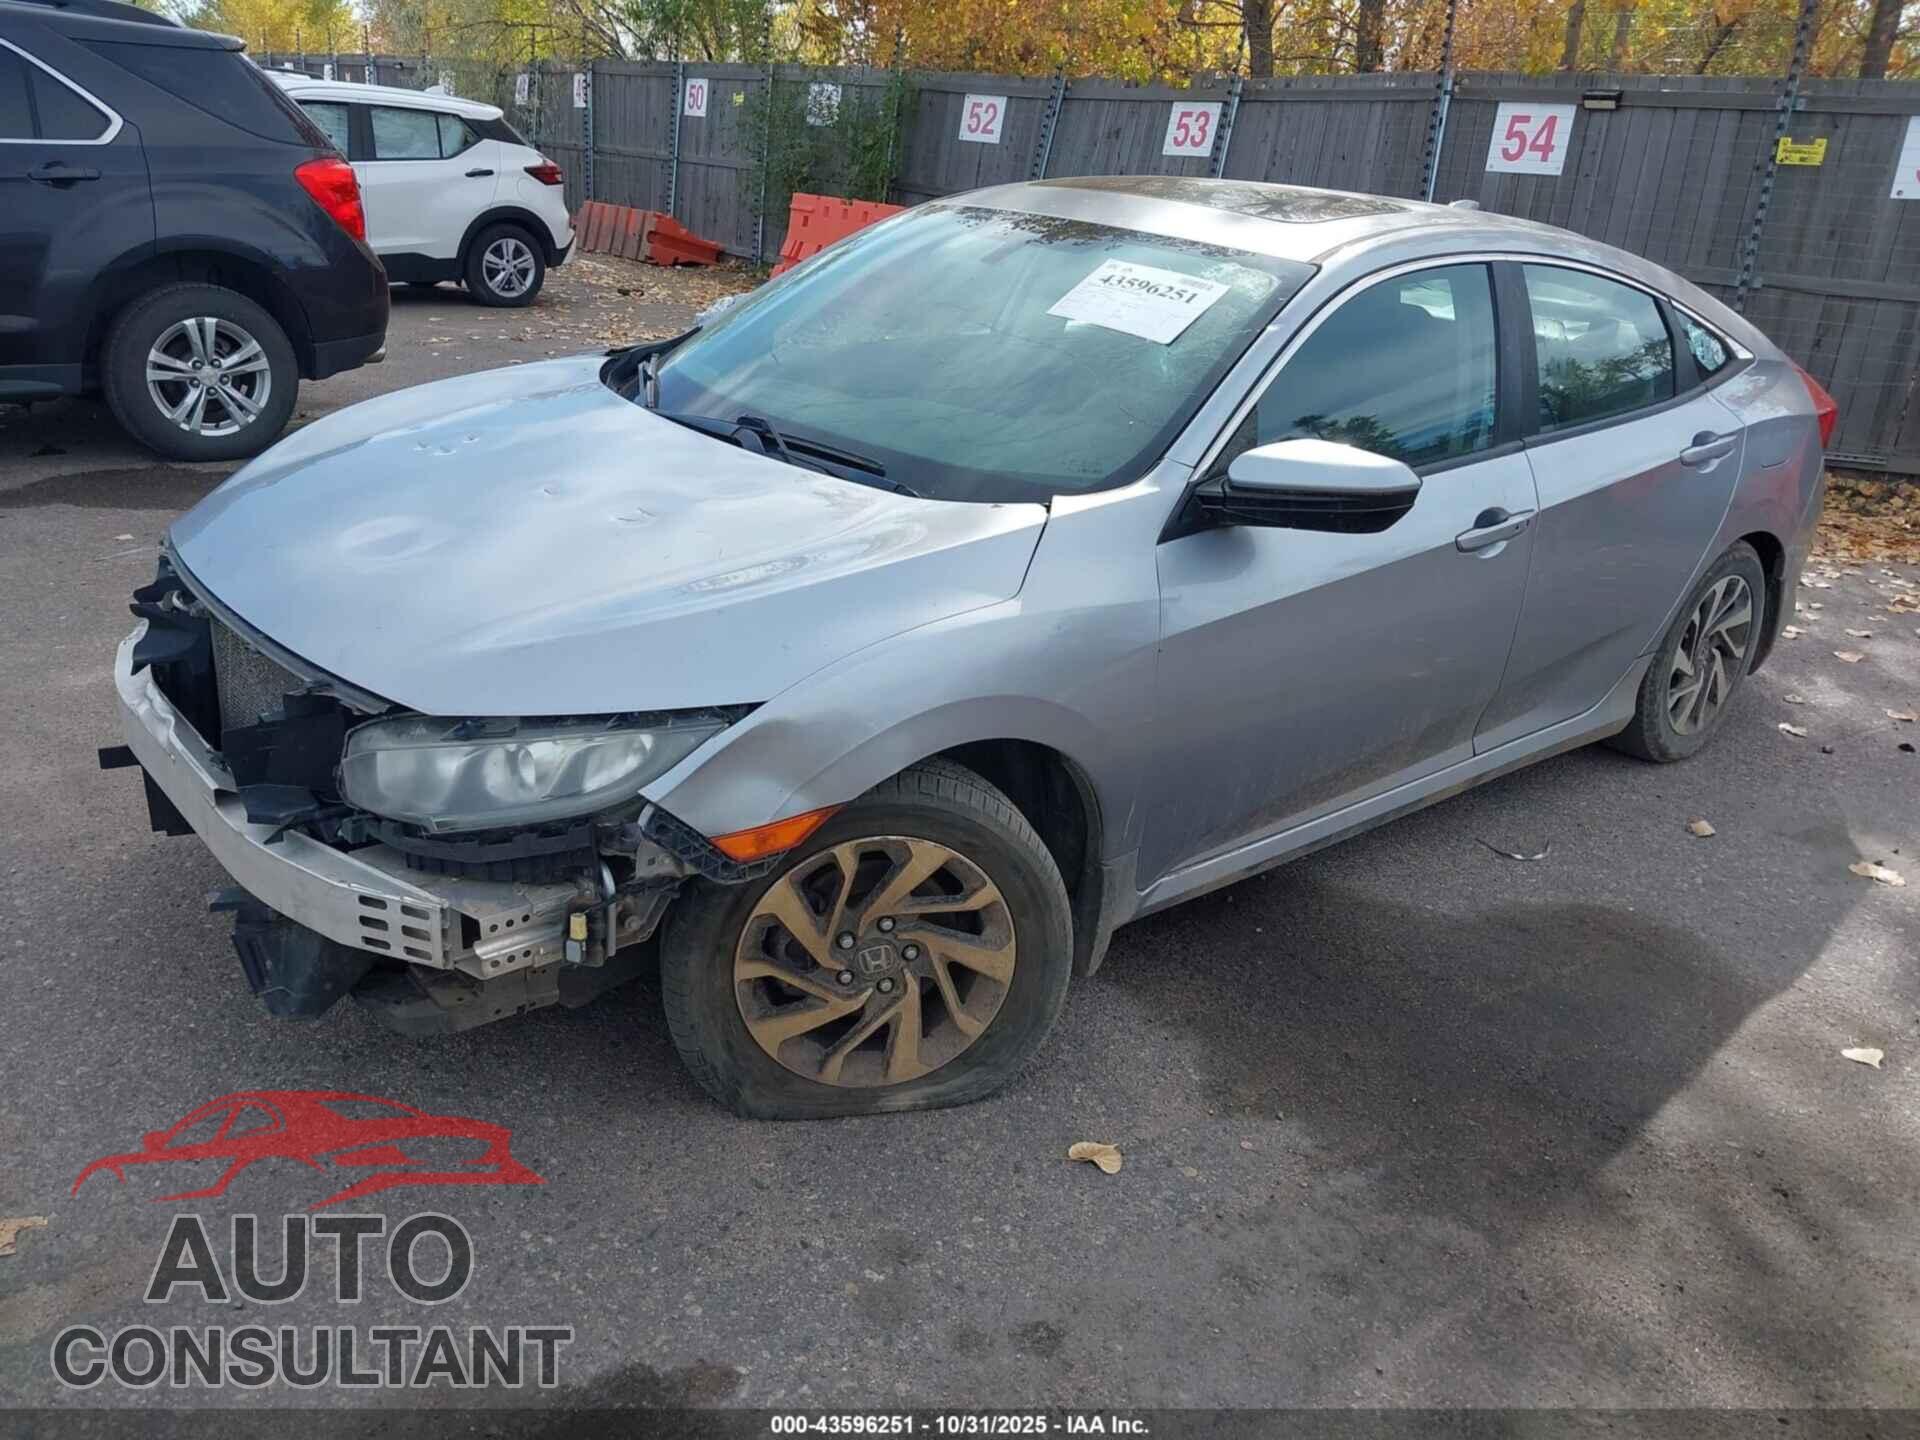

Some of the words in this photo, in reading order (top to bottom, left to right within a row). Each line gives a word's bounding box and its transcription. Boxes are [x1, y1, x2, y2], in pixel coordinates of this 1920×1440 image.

[688, 84, 704, 110] 50
[967, 102, 998, 135] 52
[1173, 111, 1211, 148] 53
[1501, 114, 1558, 163] 54
[1099, 274, 1198, 304] 43596251
